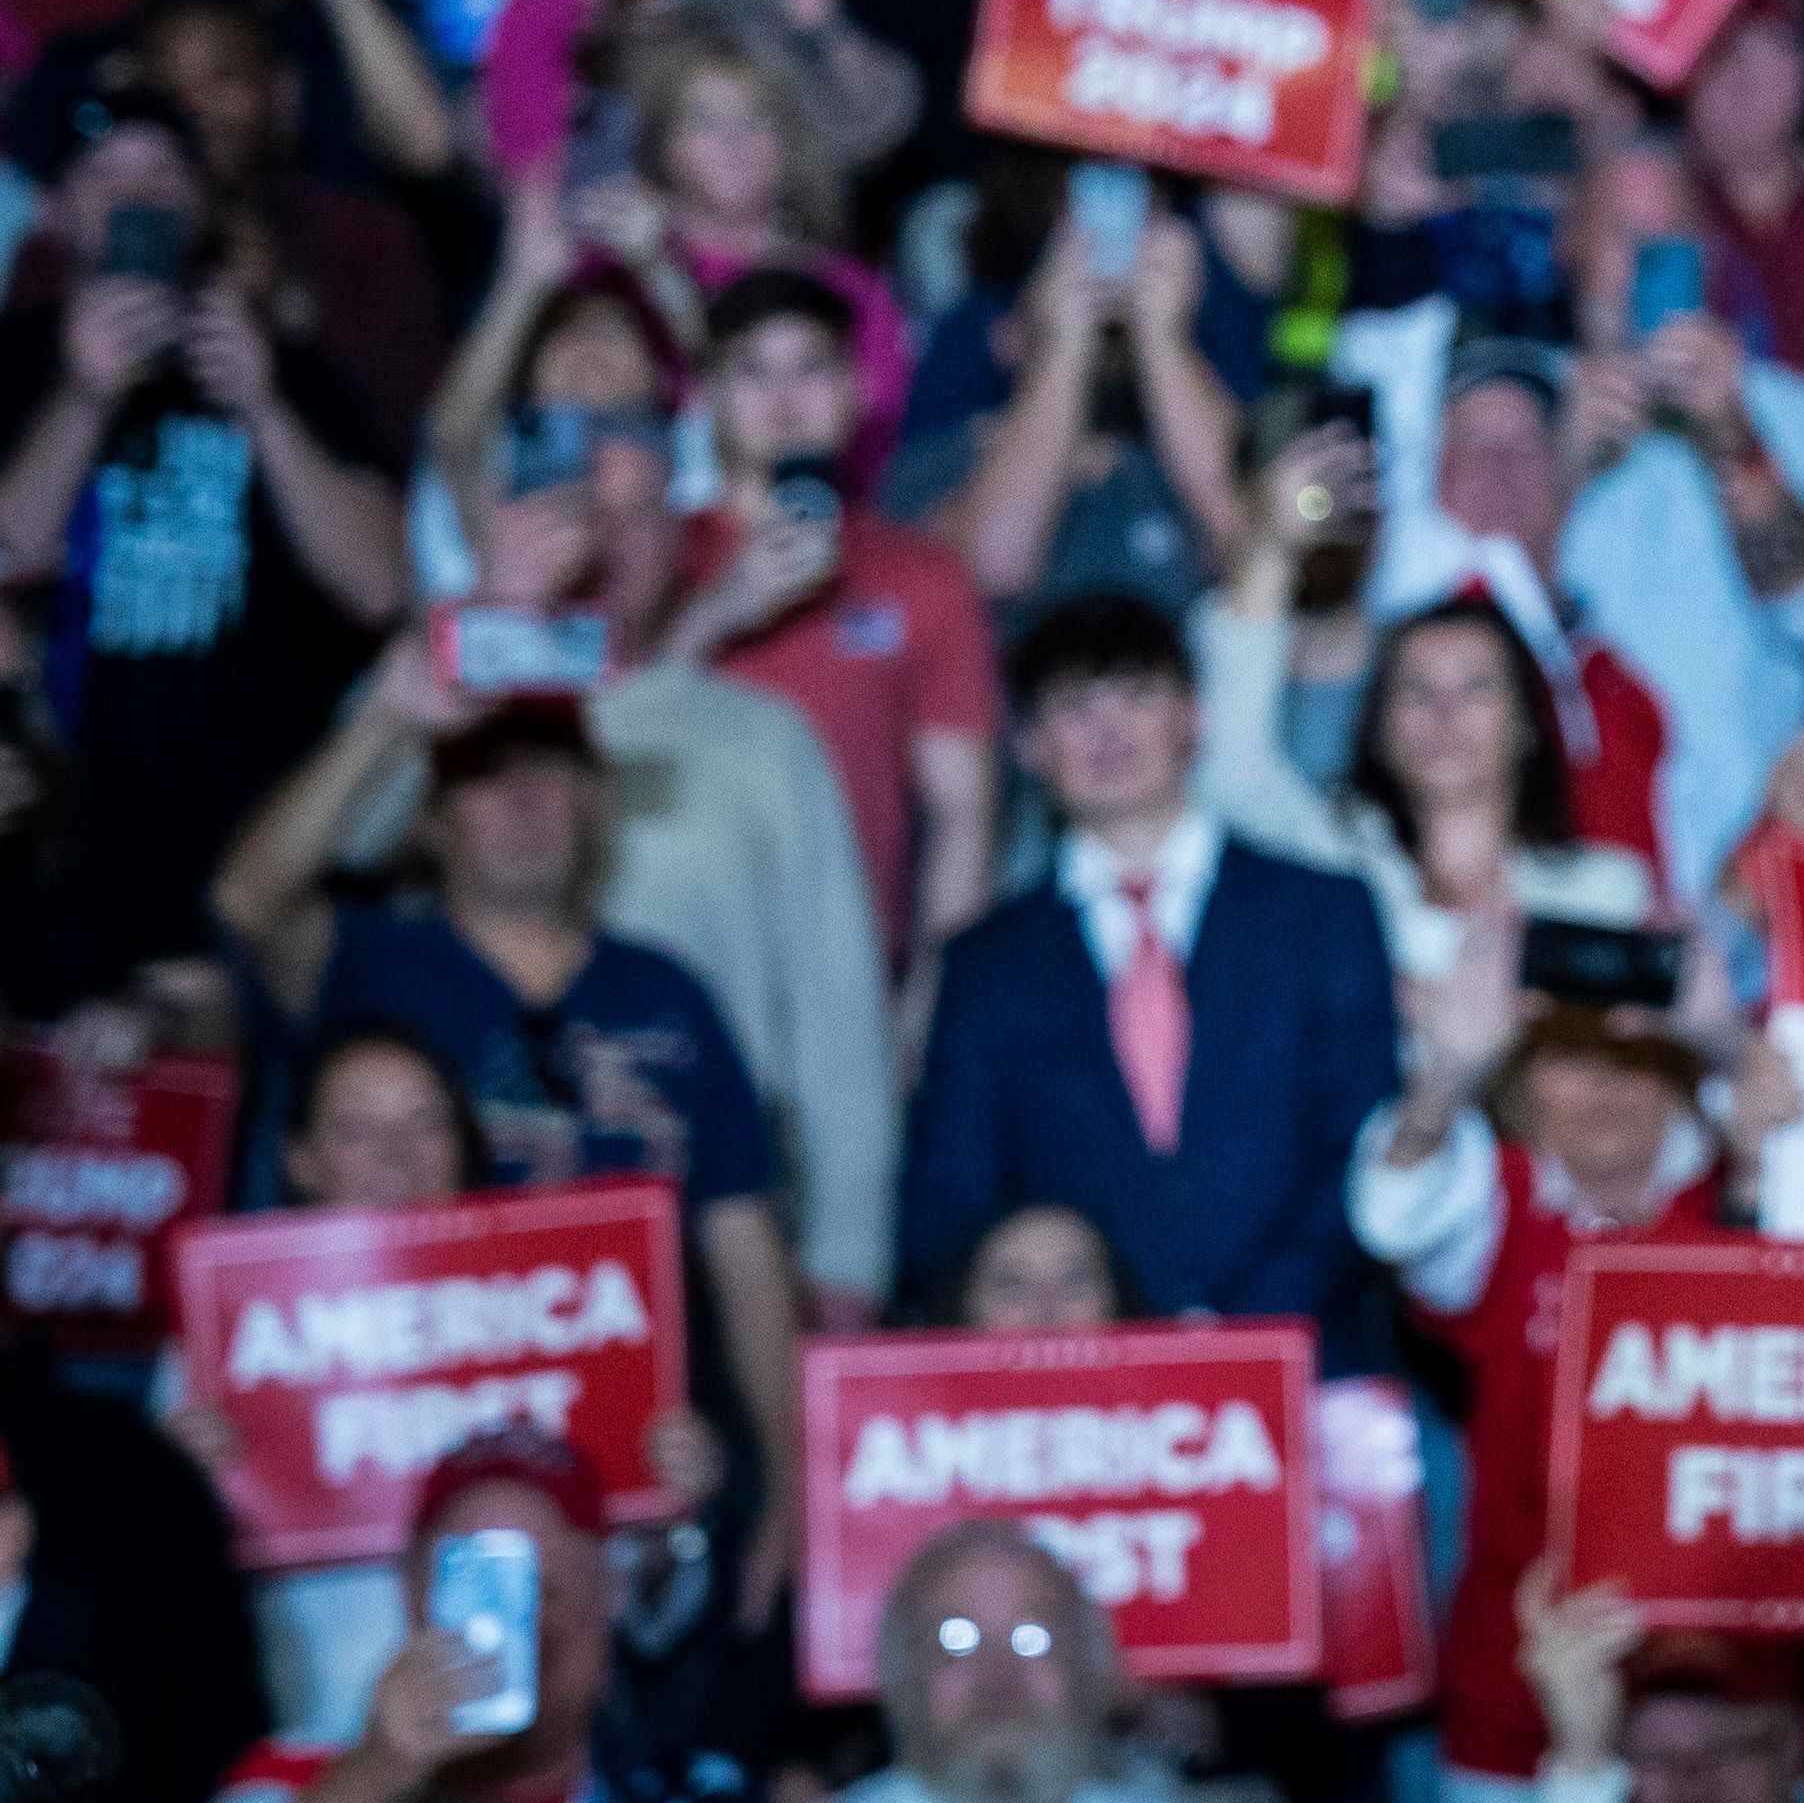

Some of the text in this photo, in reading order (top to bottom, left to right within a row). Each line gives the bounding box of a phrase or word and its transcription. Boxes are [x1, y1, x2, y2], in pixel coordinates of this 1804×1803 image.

[1062, 32, 1277, 150] 2024
[228, 1258, 650, 1393] AMERICA
[842, 1398, 1284, 1510] AMERICA
